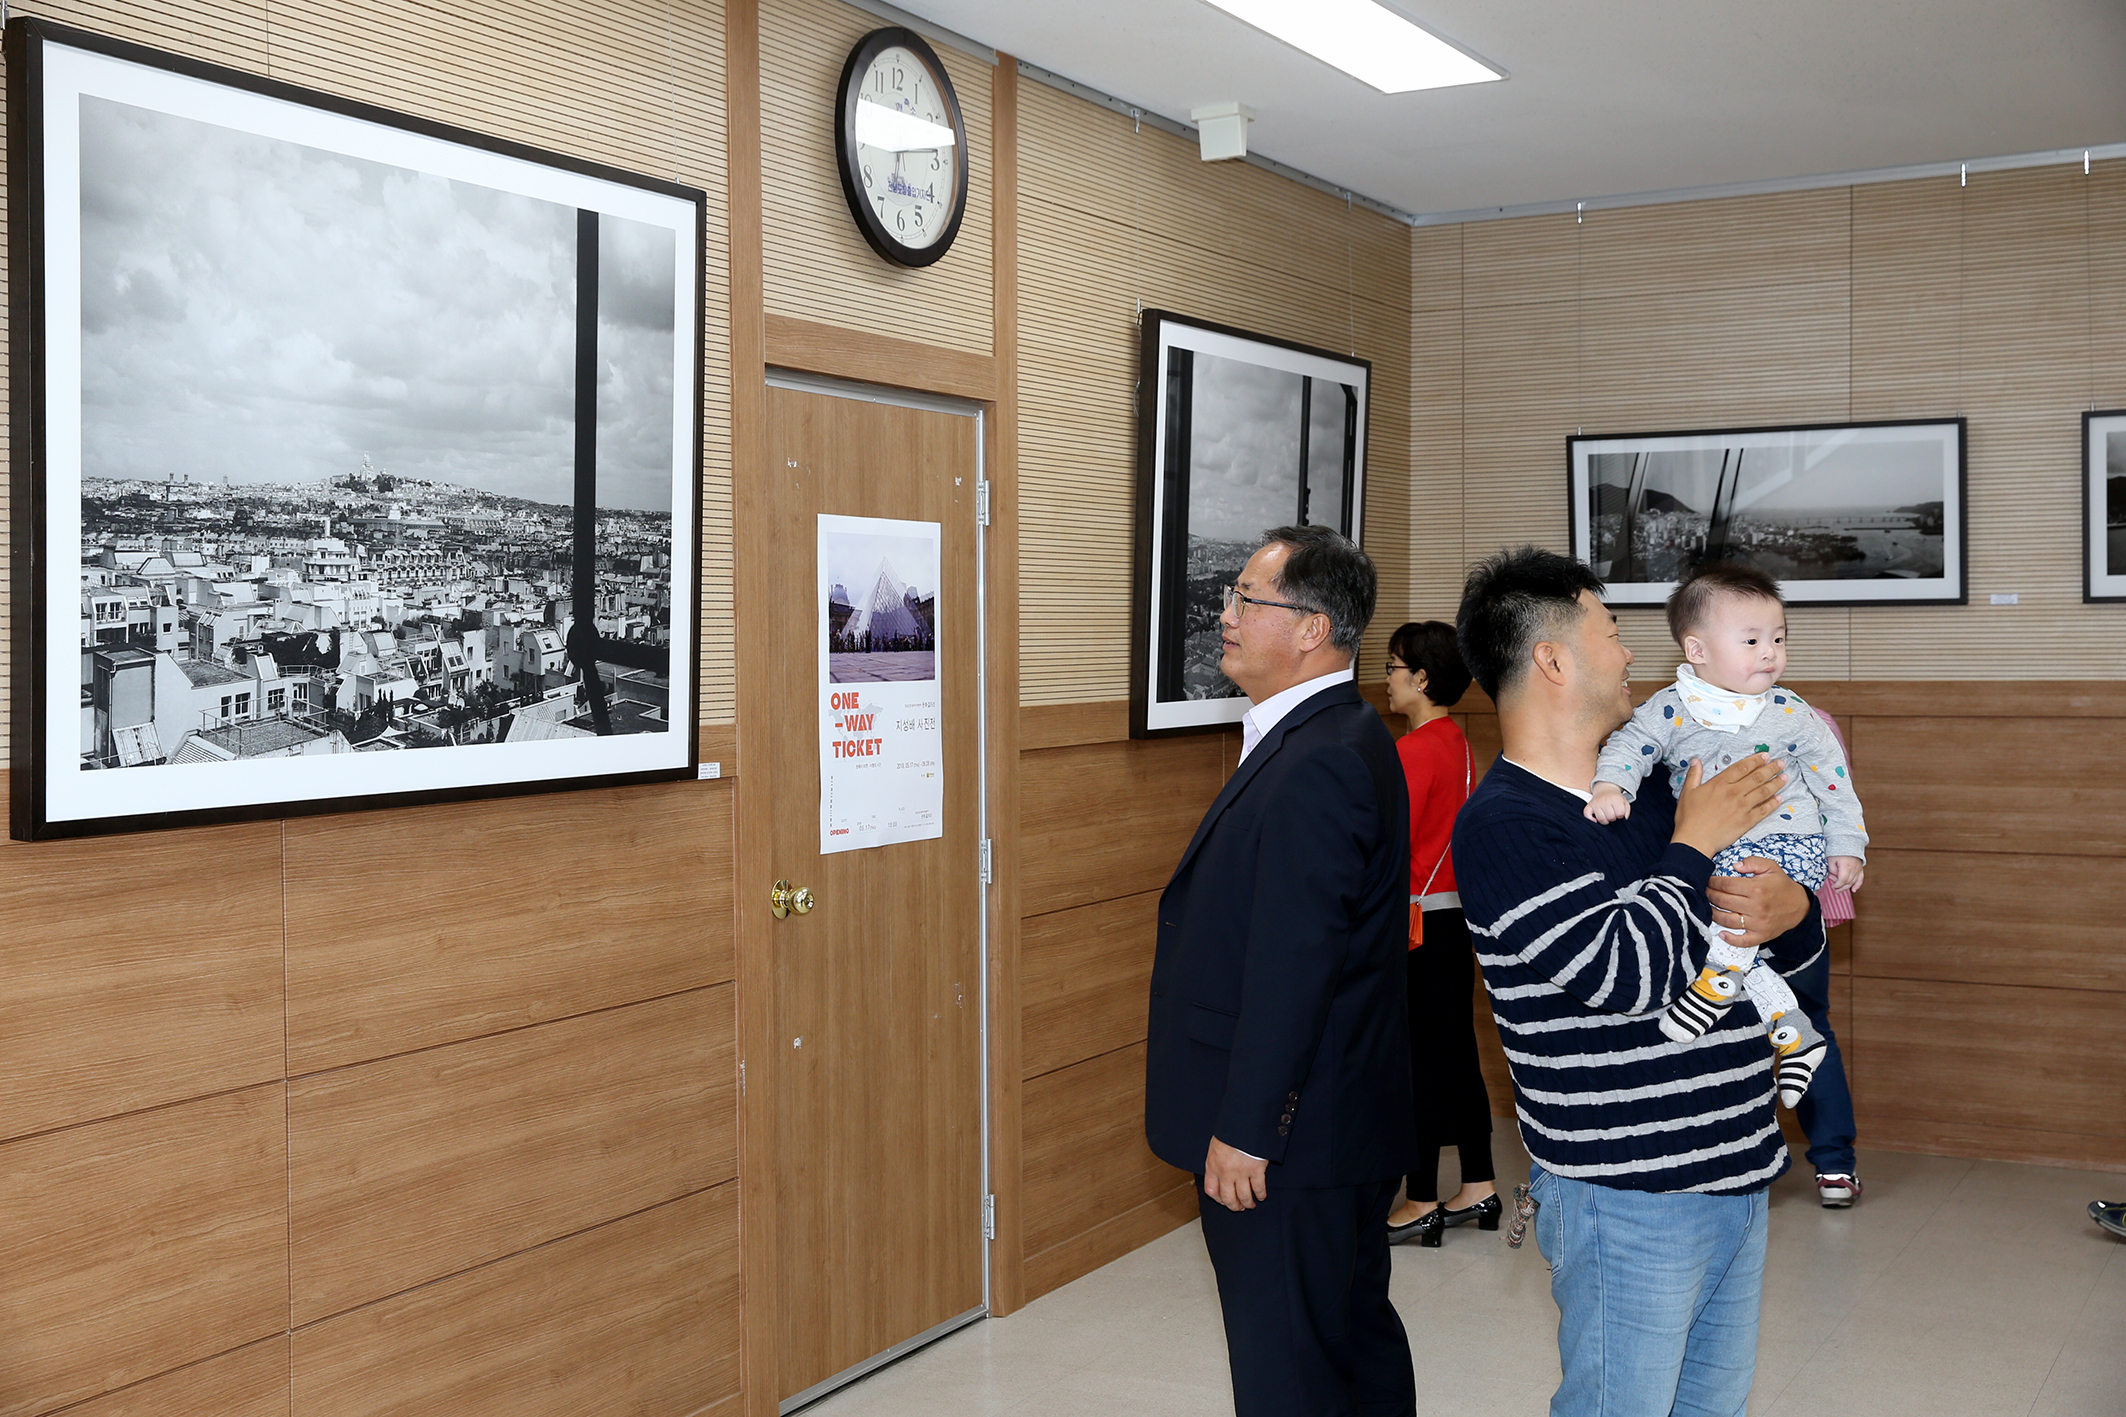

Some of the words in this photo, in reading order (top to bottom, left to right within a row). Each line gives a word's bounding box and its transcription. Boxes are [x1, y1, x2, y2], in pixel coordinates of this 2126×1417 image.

[875, 70, 884, 94] 11
[892, 67, 904, 91] 12
[914, 83, 918, 105] 1
[931, 148, 940, 171] 3
[863, 164, 873, 189] 8
[926, 181, 935, 204] 4
[877, 195, 885, 219] 7
[914, 204, 924, 227] 5
[896, 209, 906, 232] 6
[830, 692, 859, 710] ONE
[896, 718, 915, 732] 지성배
[917, 716, 935, 730] 사진전
[832, 738, 882, 758] TICKET
